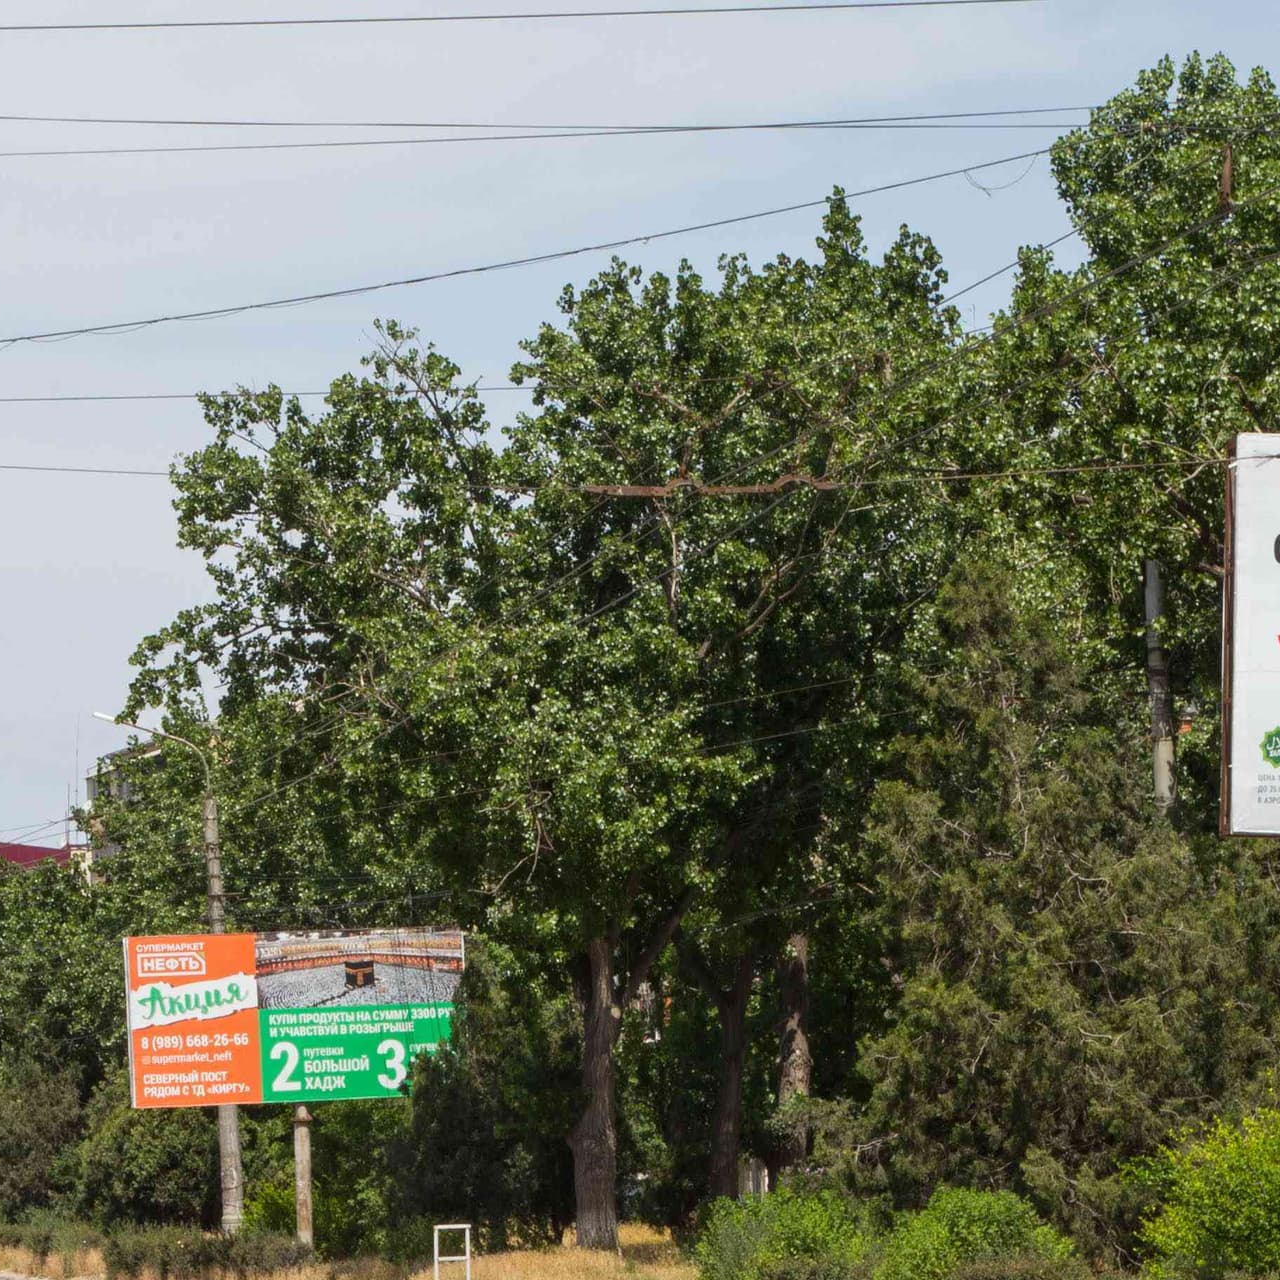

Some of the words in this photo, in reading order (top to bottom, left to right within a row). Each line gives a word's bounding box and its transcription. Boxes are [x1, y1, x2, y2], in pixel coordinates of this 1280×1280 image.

[136, 942, 205, 953] СУПЕРМАРКЕТ
[143, 956, 201, 972] НЕФТЬ
[137, 982, 249, 1020] Акция
[269, 1013, 297, 1025] КУПИ
[299, 1011, 355, 1025] ПРОДУКТЫ
[356, 1010, 371, 1022] НА
[372, 1008, 409, 1021] СУММУ
[269, 1027, 278, 1038] И
[279, 1022, 339, 1038] УЧАВСТВУЙ
[340, 1023, 347, 1035] В
[349, 1020, 415, 1035] РОЗЫГРЫШЕ
[140, 1036, 149, 1050] 8
[151, 1034, 184, 1052] (989)
[270, 1041, 302, 1092] 2
[303, 1046, 345, 1059] путевки
[304, 1054, 370, 1074] БОЛЬШОЙ
[377, 1039, 408, 1090] 3
[143, 1069, 199, 1085] СЕВЕРНЫЙ
[201, 1071, 228, 1082] ПОСТ
[305, 1075, 346, 1092] ХАДЖ
[143, 1085, 181, 1098] РЯДОМ
[182, 1086, 190, 1096] С
[192, 1084, 206, 1097] ТД
[207, 1082, 251, 1094] «КИРГУ»
